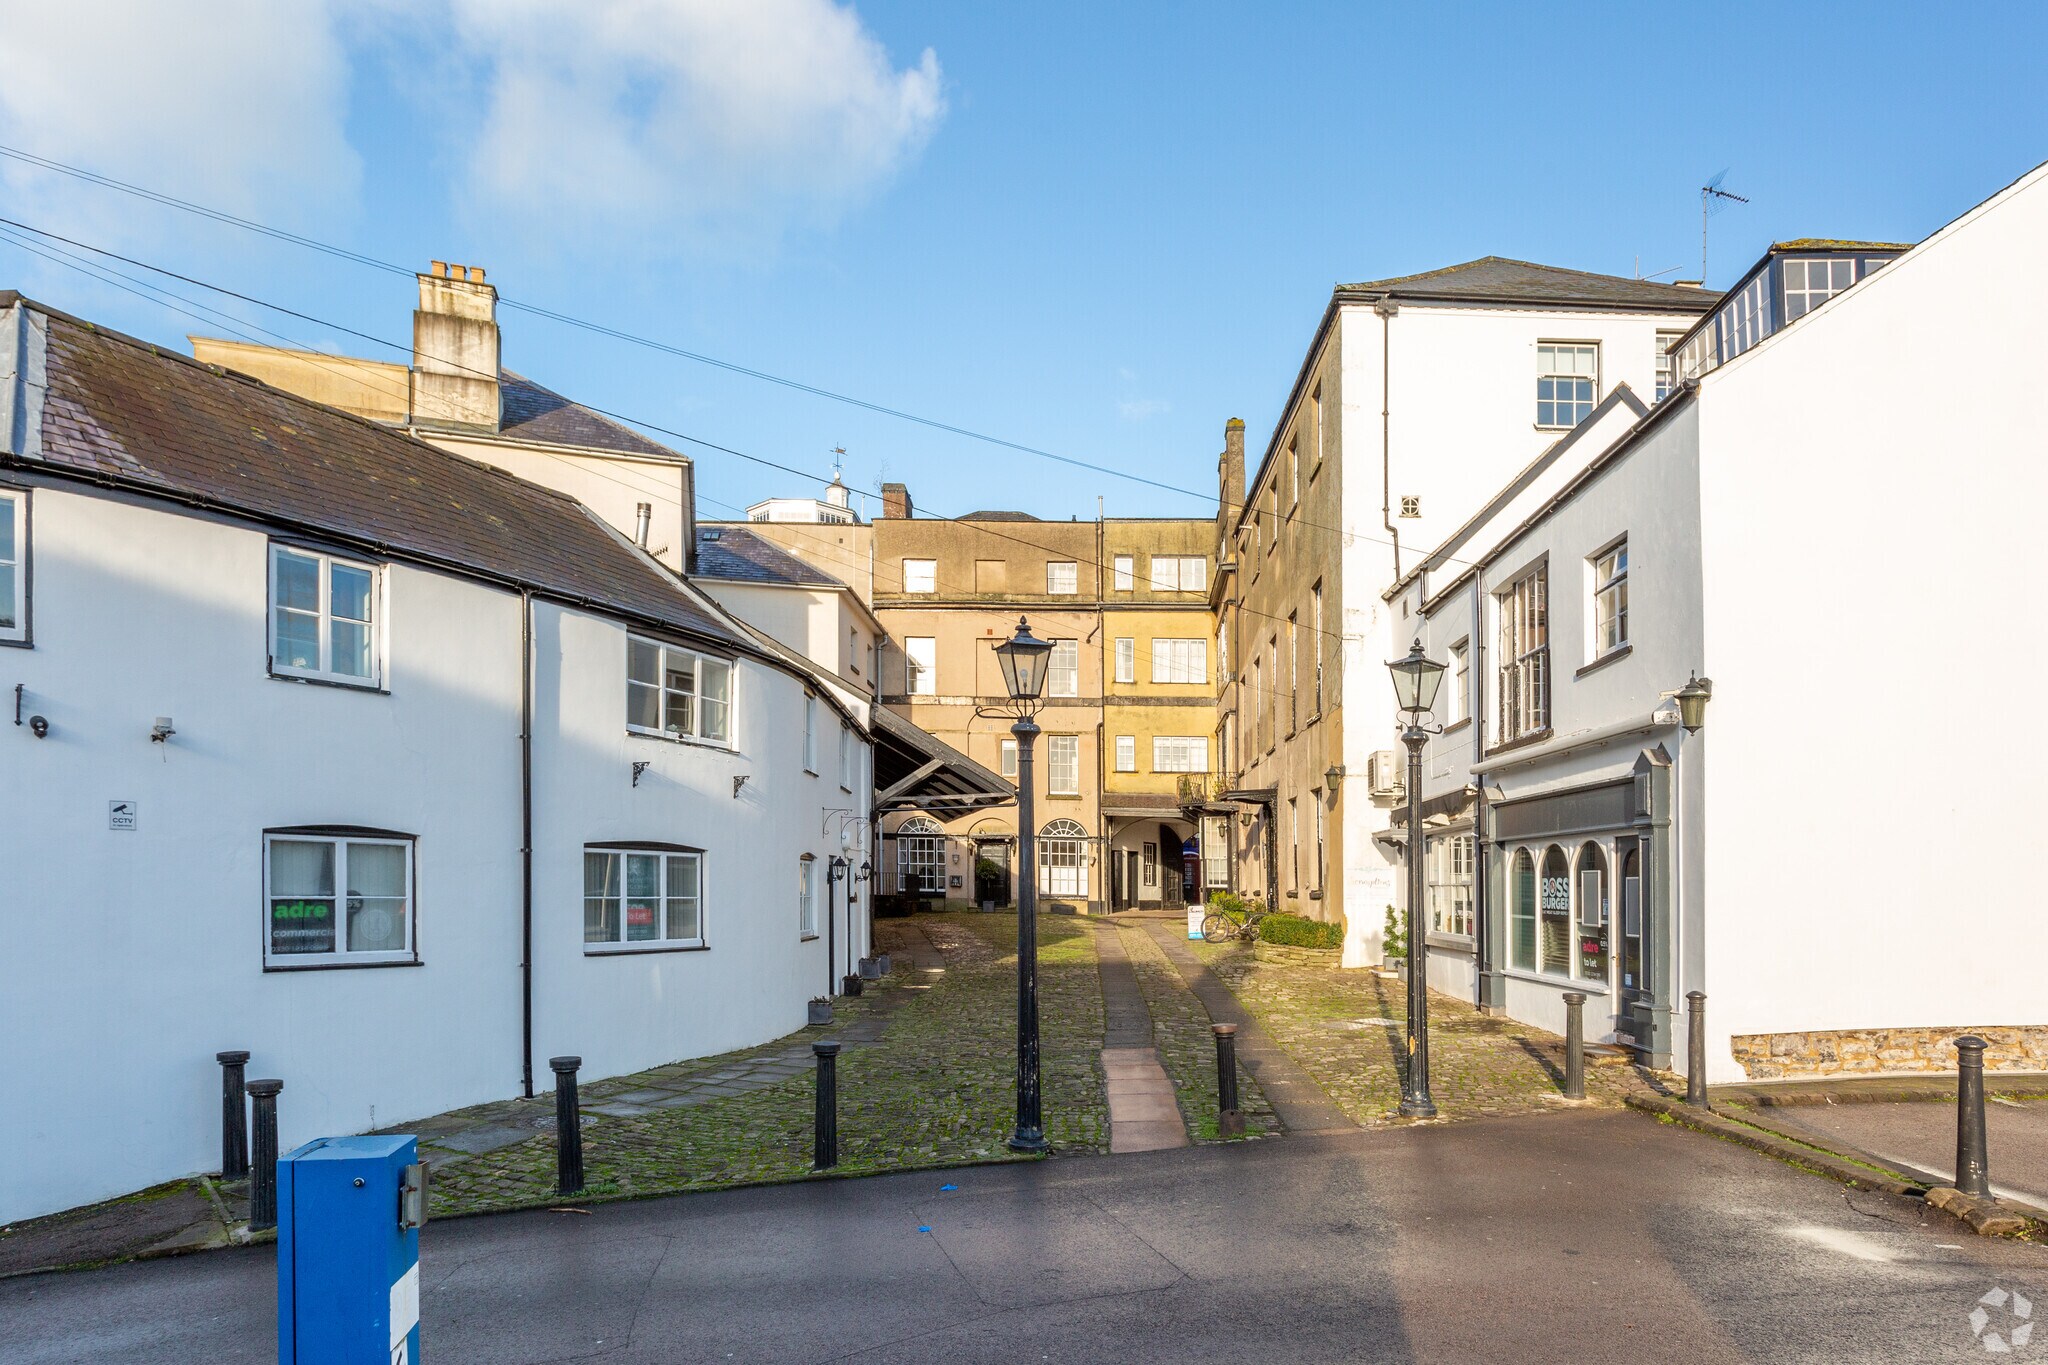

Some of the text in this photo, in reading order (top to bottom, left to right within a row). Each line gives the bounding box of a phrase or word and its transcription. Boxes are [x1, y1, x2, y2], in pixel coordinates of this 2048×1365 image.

[1542, 877, 1568, 897] BOSS
[347, 900, 361, 908] 5%
[273, 901, 329, 919] adre
[273, 928, 336, 938] commercia
[1582, 941, 1599, 953] adre
[1583, 958, 1598, 968] to let
